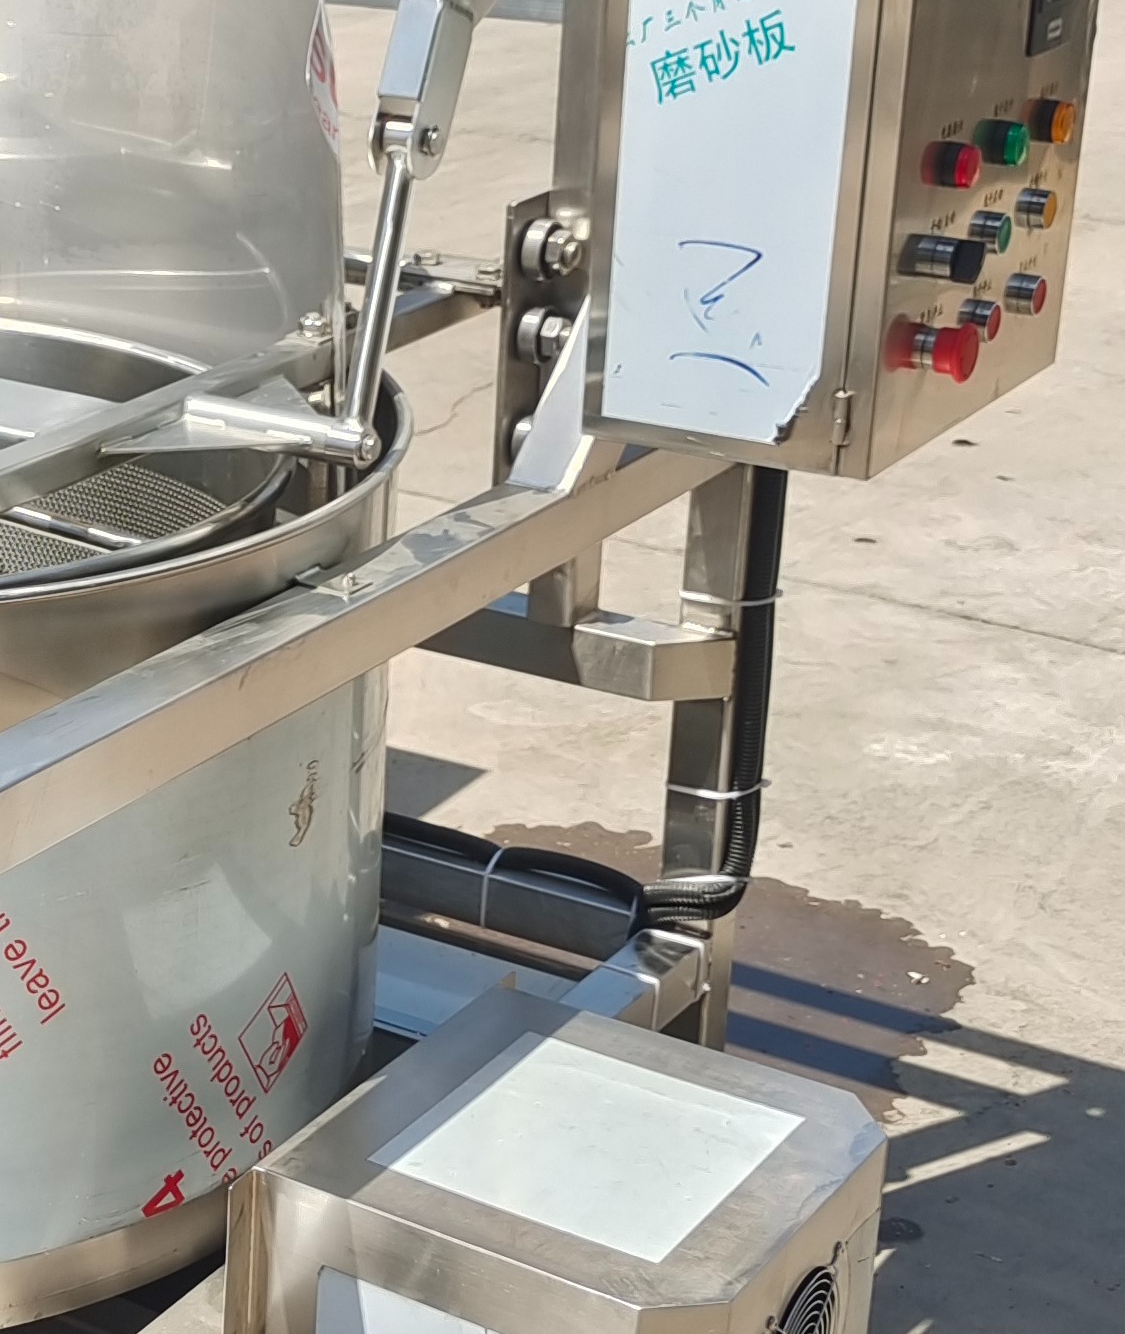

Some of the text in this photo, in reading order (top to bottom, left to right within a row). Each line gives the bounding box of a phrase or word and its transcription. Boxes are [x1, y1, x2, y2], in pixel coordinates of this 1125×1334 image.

[650, 9, 796, 105] 磨砂板
[4, 939, 66, 1026] leave
[154, 1053, 234, 1172] protective
[191, 1014, 257, 1120] products
[239, 1115, 264, 1144] of
[141, 1170, 185, 1219] 4
